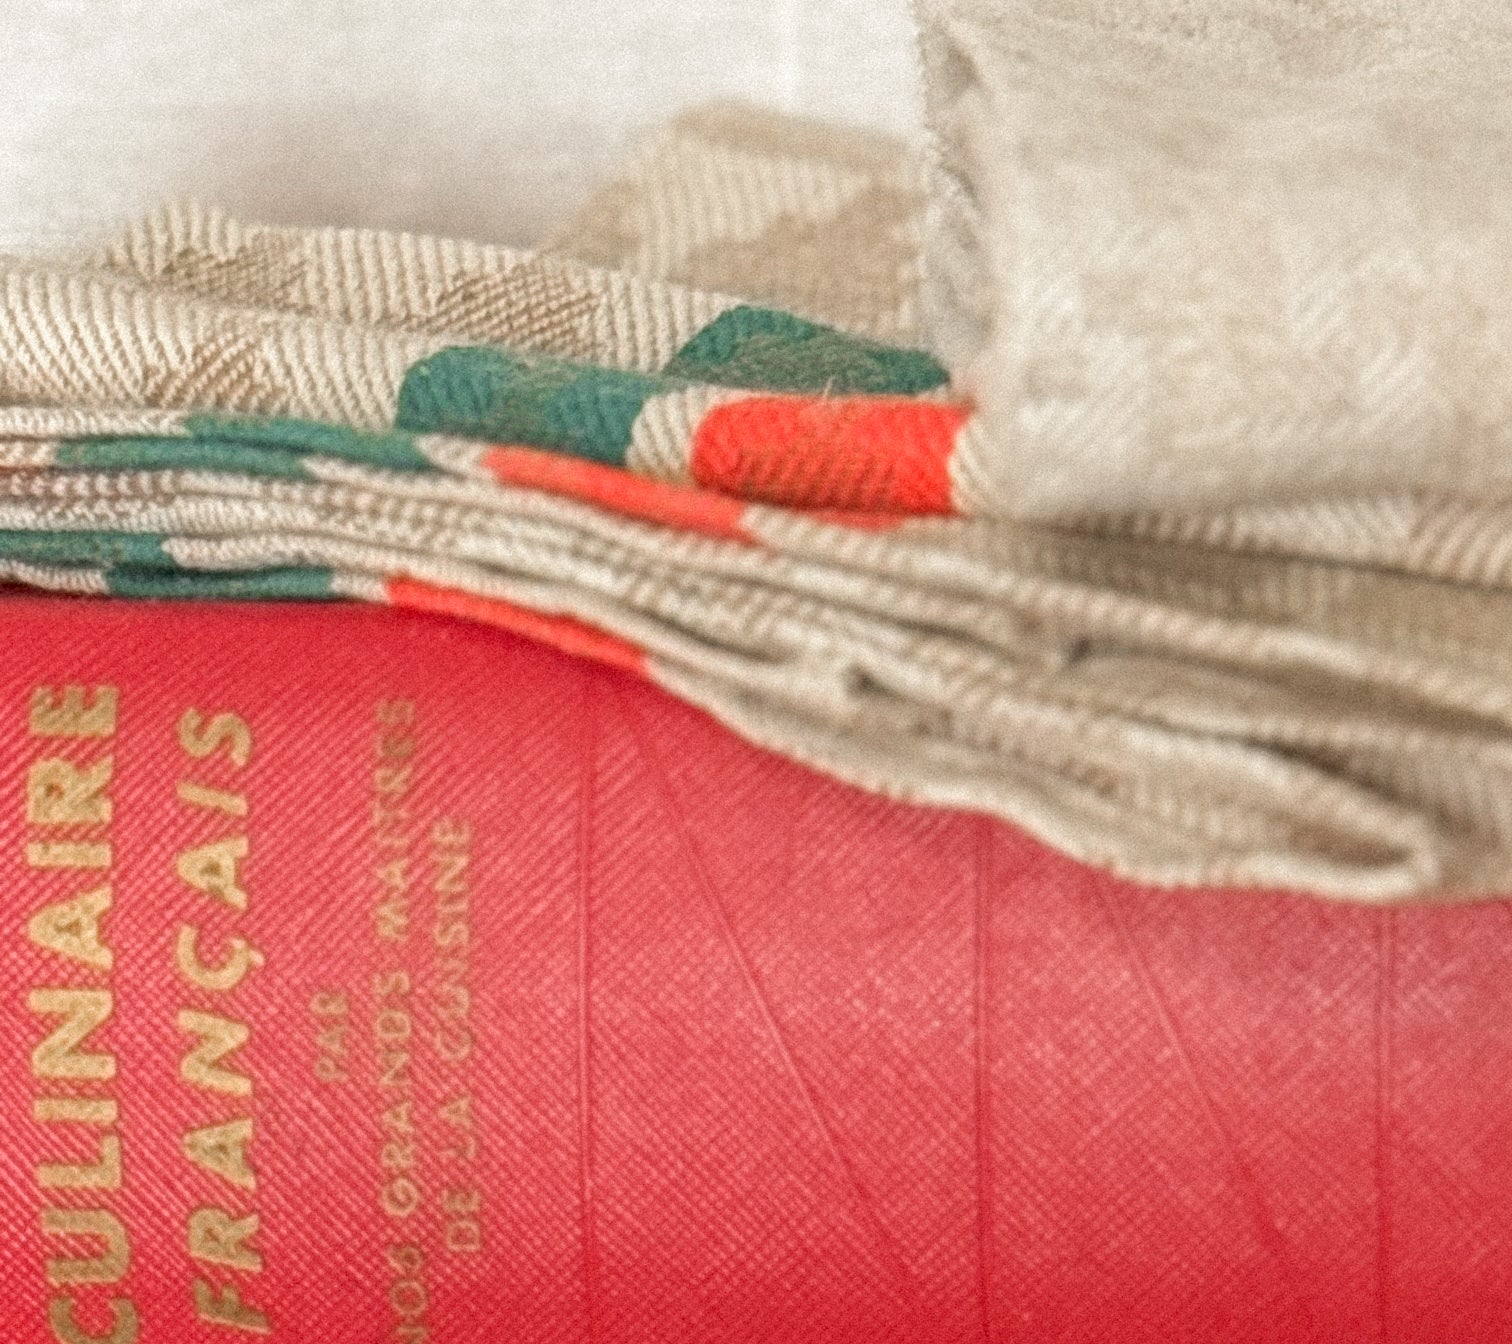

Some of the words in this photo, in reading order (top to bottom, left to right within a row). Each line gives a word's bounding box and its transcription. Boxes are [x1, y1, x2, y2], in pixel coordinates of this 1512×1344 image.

[176, 706, 271, 1335] FRANÇAIS
[312, 990, 349, 1083] PAR
[433, 815, 474, 1062] CUISINE
[374, 969, 421, 1217] GRANDS
[446, 1183, 482, 1254] DE
